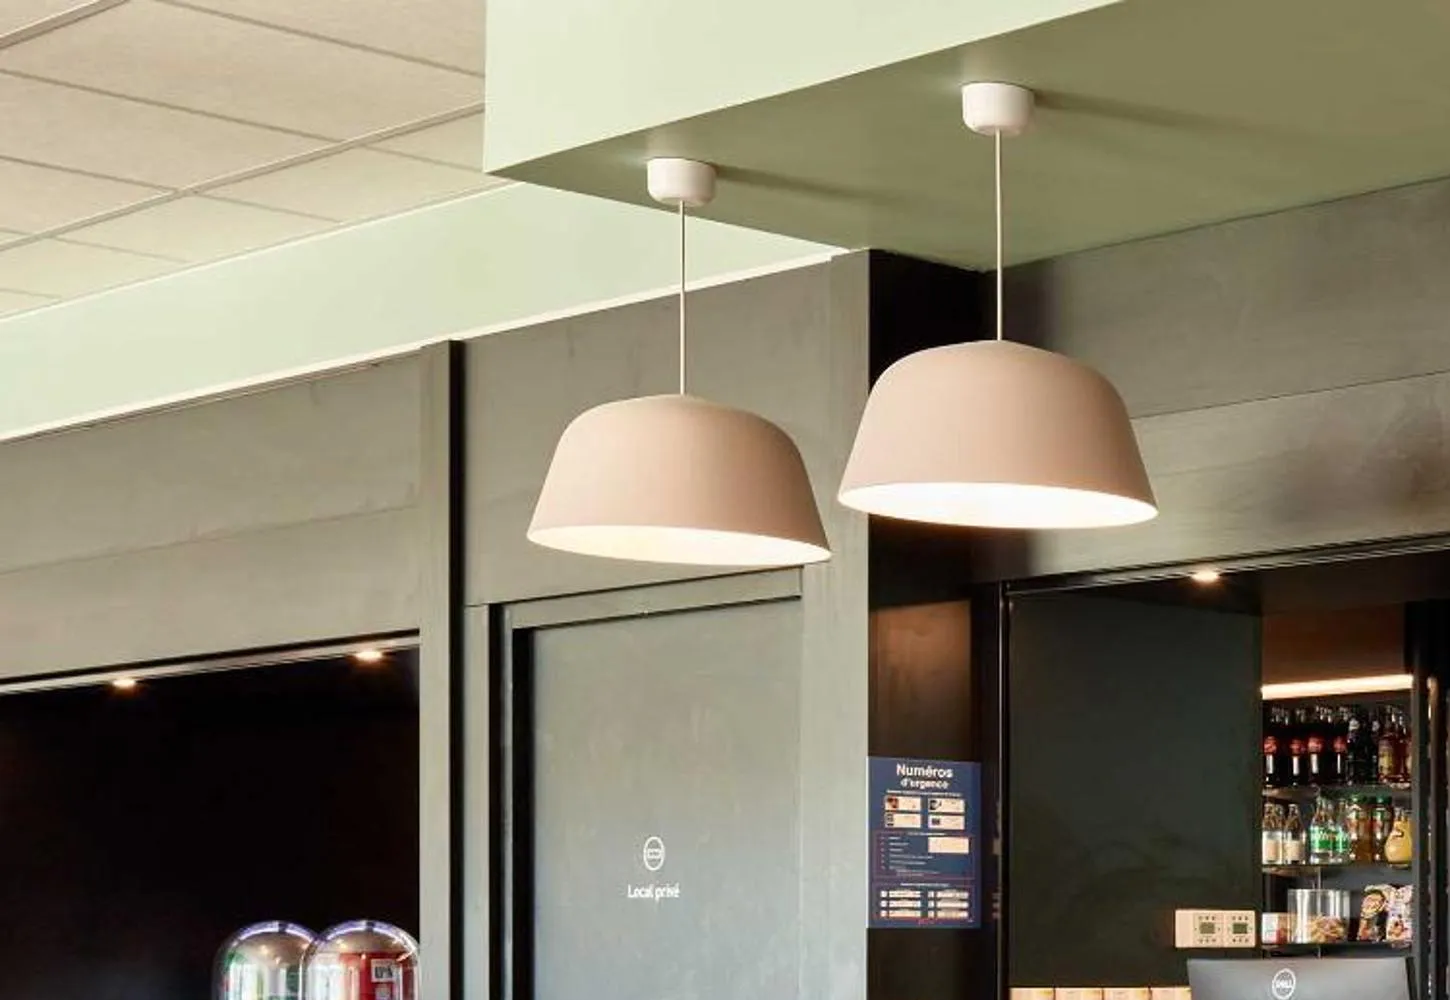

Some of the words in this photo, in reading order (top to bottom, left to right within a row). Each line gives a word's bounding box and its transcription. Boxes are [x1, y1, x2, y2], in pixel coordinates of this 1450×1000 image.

[896, 763, 954, 779] Numéros
[900, 778, 951, 790] d'urgence
[627, 883, 654, 898] Local
